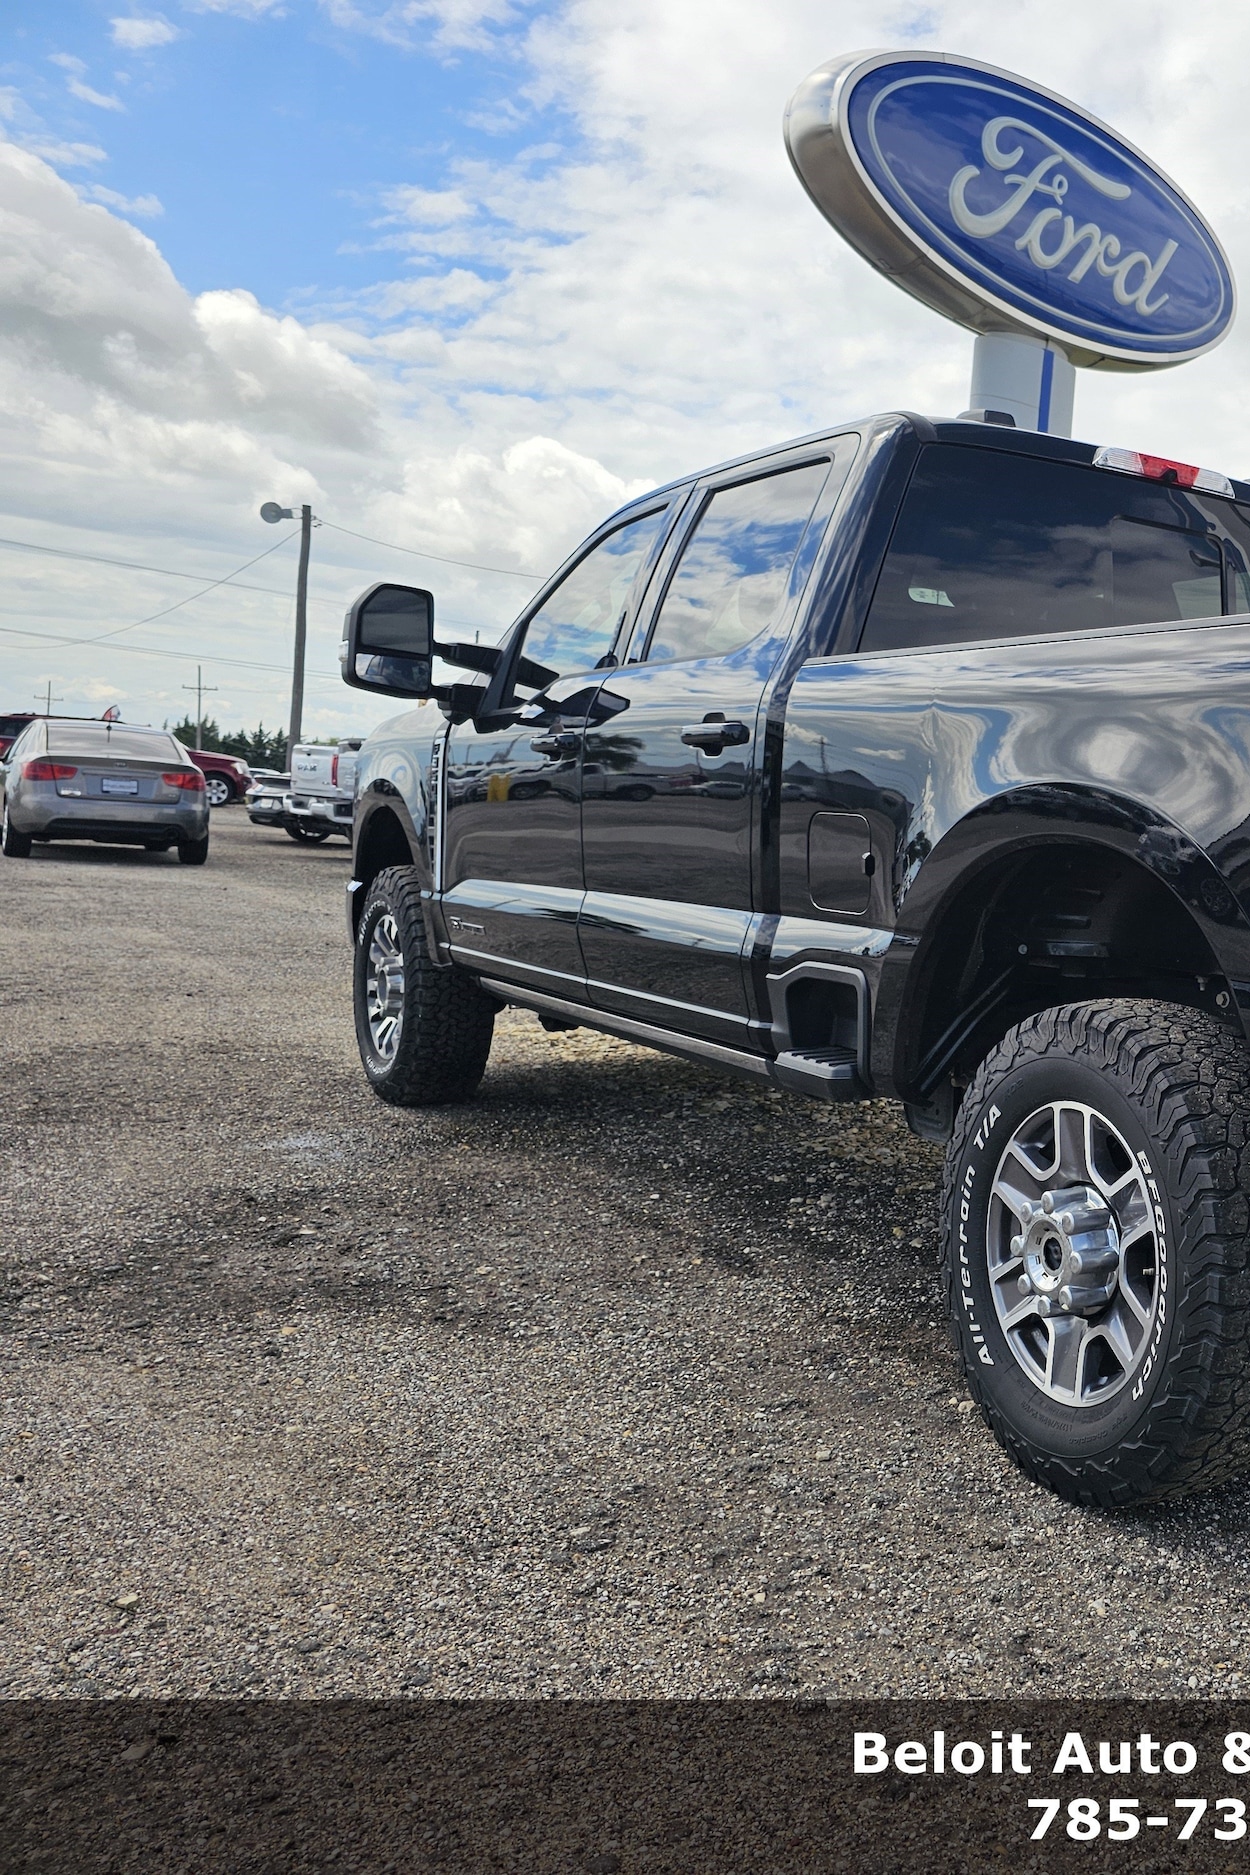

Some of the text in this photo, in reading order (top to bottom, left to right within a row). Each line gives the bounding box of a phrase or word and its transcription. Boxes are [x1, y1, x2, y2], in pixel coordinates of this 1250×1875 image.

[949, 116, 1178, 316] Ford
[958, 1104, 1002, 1367] All-Terrain T/A
[1131, 1150, 1169, 1401] BFGoodrich
